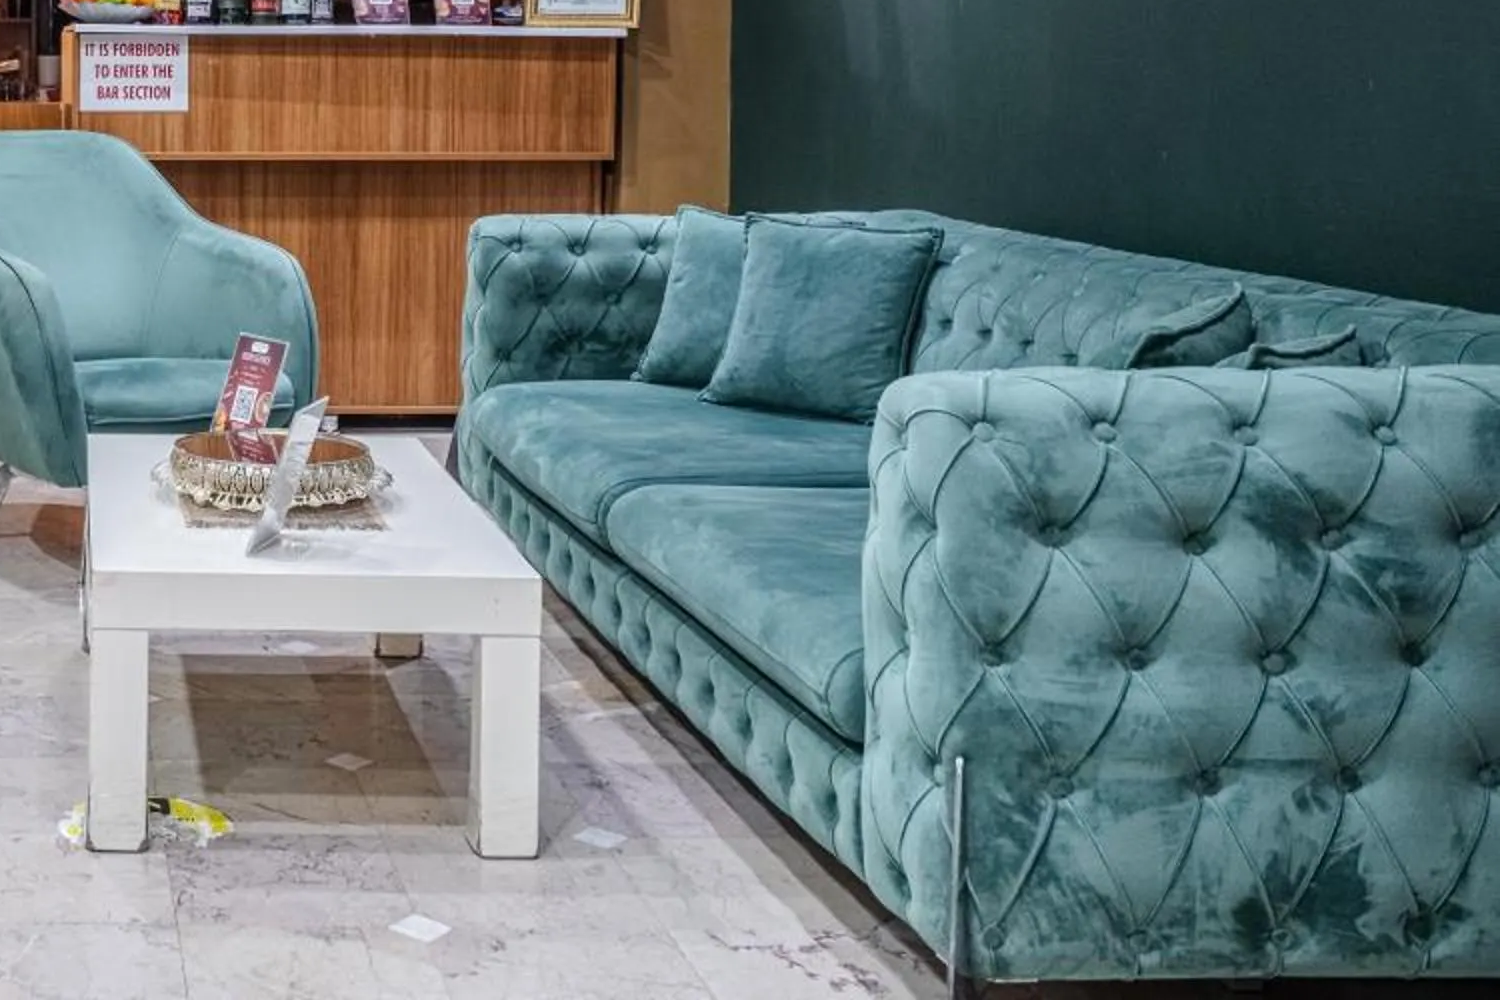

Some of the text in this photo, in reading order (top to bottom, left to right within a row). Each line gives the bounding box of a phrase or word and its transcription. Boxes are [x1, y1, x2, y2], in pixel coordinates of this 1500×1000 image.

[85, 43, 180, 57] IT IS FORBIDDEN
[94, 64, 174, 79] TO ENTER THE
[97, 85, 171, 100] BAR SECTION
